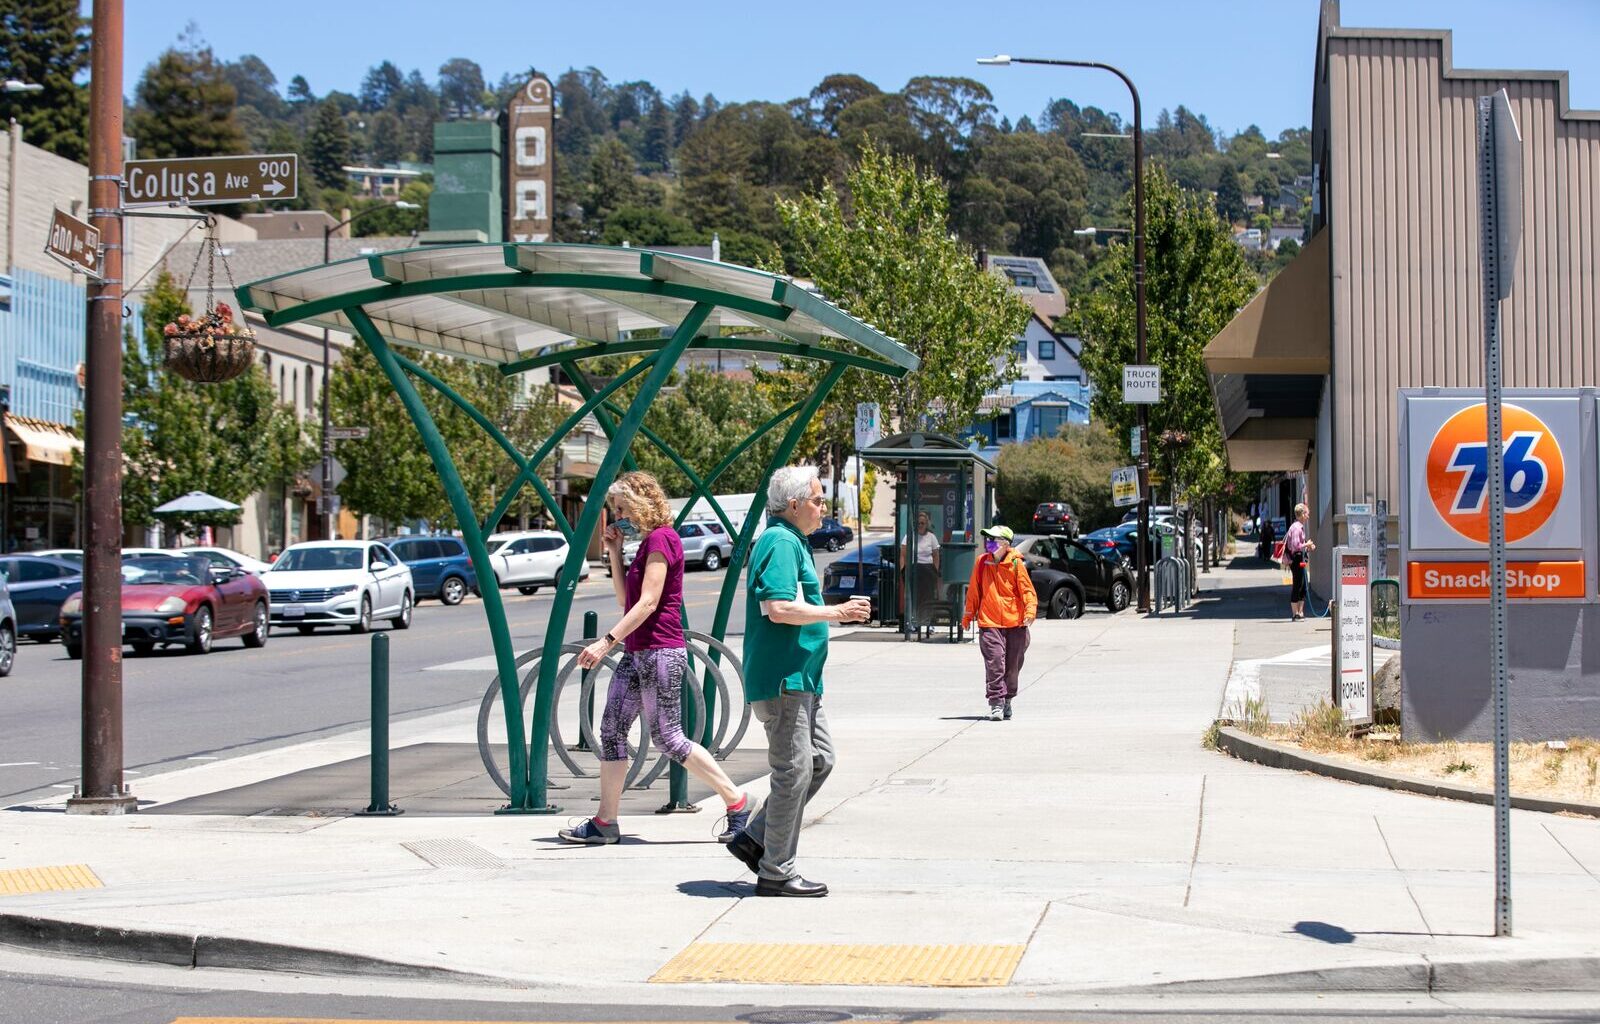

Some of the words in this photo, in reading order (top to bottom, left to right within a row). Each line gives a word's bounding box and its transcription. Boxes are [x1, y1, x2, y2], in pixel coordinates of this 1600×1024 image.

[129, 166, 216, 199] Colusa
[225, 172, 249, 189] Ave
[258, 160, 290, 178] 900
[513, 126, 549, 242] OA
[1126, 370, 1157, 378] TRUCK
[1445, 431, 1548, 515] 76
[1424, 569, 1492, 588] Snack
[1505, 570, 1561, 591] Shop
